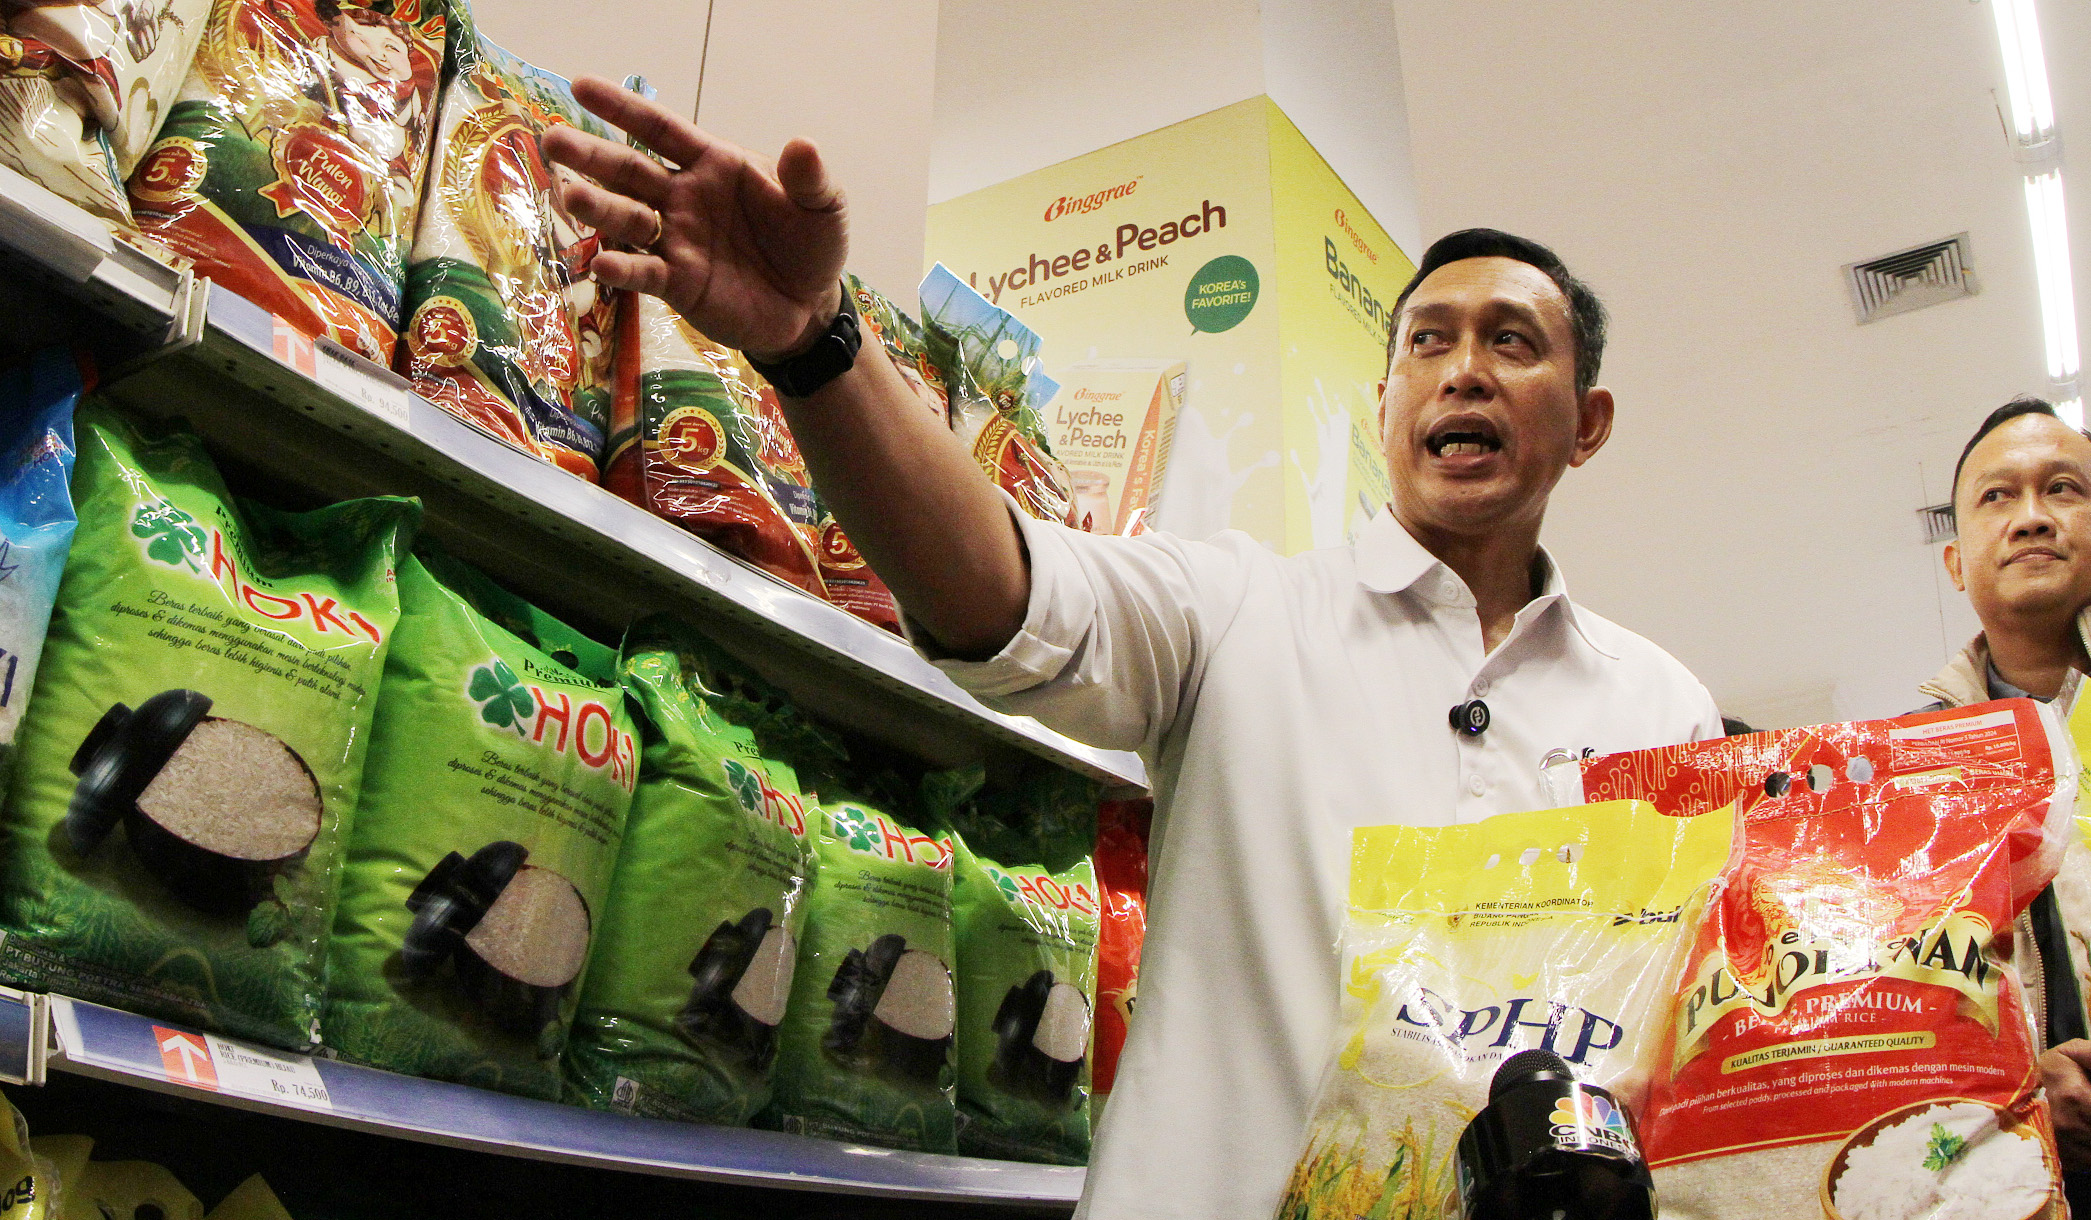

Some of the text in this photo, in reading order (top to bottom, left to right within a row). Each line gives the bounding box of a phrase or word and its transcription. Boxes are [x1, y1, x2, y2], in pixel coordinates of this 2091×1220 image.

[146, 158, 176, 182] 5
[309, 144, 354, 190] Pulen
[165, 176, 179, 186] kg
[298, 160, 347, 208] Wangi
[1044, 180, 1138, 222] Binggrae
[1095, 243, 1112, 265] &
[1116, 199, 1227, 260] Peach
[1334, 208, 1379, 265] Binggrae
[307, 244, 349, 267] Diperkaya
[1020, 254, 1169, 309] FLAVORED MILK DRINK
[1198, 279, 1247, 295] KOREA's
[1190, 291, 1252, 309] FAVORITE!
[361, 387, 408, 422] Rp. 94,500
[1074, 388, 1122, 403] Binggrae
[1056, 405, 1124, 431] Lychee
[678, 428, 699, 452] 5
[1059, 427, 1127, 449] & Peach
[698, 446, 710, 455] kg
[1132, 429, 1156, 485] Korea's
[830, 532, 848, 554] 5
[147, 590, 185, 610] Beras
[188, 603, 224, 621] terbaik
[221, 616, 251, 633] yang
[110, 602, 148, 618] diproses
[152, 610, 167, 622] &
[166, 615, 206, 634] dikemas
[208, 629, 274, 656] menggunakan
[276, 650, 300, 666] mesin
[302, 658, 346, 688] berteknologi
[148, 628, 192, 648] sehingga
[195, 639, 220, 656] beras
[224, 648, 248, 664] lebih
[249, 656, 282, 676] higienis
[285, 668, 298, 681] &
[295, 676, 318, 690] putih
[1954, 720, 1983, 730] PREMIUM
[481, 750, 512, 770] Beras
[484, 769, 497, 780] &
[1475, 902, 1534, 910] KEMENTERIAN
[1470, 920, 1510, 928] REPUBLIK
[2, 959, 38, 978] Jakarta
[6, 945, 21, 958] PT
[23, 953, 76, 978] BUYUNG
[1806, 991, 1923, 1014] PREMIUM
[1844, 1013, 1877, 1024] RICE
[1730, 1052, 1770, 1069] KUALITAS
[1772, 1044, 1816, 1059] TERJAMIN
[1824, 1038, 1885, 1053] GUARANTEED
[1886, 1036, 1926, 1047] QUALITY
[270, 1079, 328, 1101] Rp. 74,500
[1689, 1092, 1715, 1108] pilihan
[1716, 1081, 1770, 1098] berkualitas,
[1772, 1075, 1796, 1089] yang
[1798, 1069, 1843, 1086] diproses
[1845, 1067, 1865, 1078] dan
[1867, 1064, 1910, 1076] dikemas
[1912, 1062, 1948, 1076] dengan
[1949, 1062, 1975, 1073] mesin
[1976, 1064, 2005, 1076] modern
[1702, 1104, 1719, 1114] From
[1720, 1099, 1748, 1111] selected
[1773, 1087, 1812, 1102] processed
[1814, 1086, 1830, 1095] and
[1830, 1080, 1868, 1094] packaged
[1889, 1078, 1918, 1086] modern
